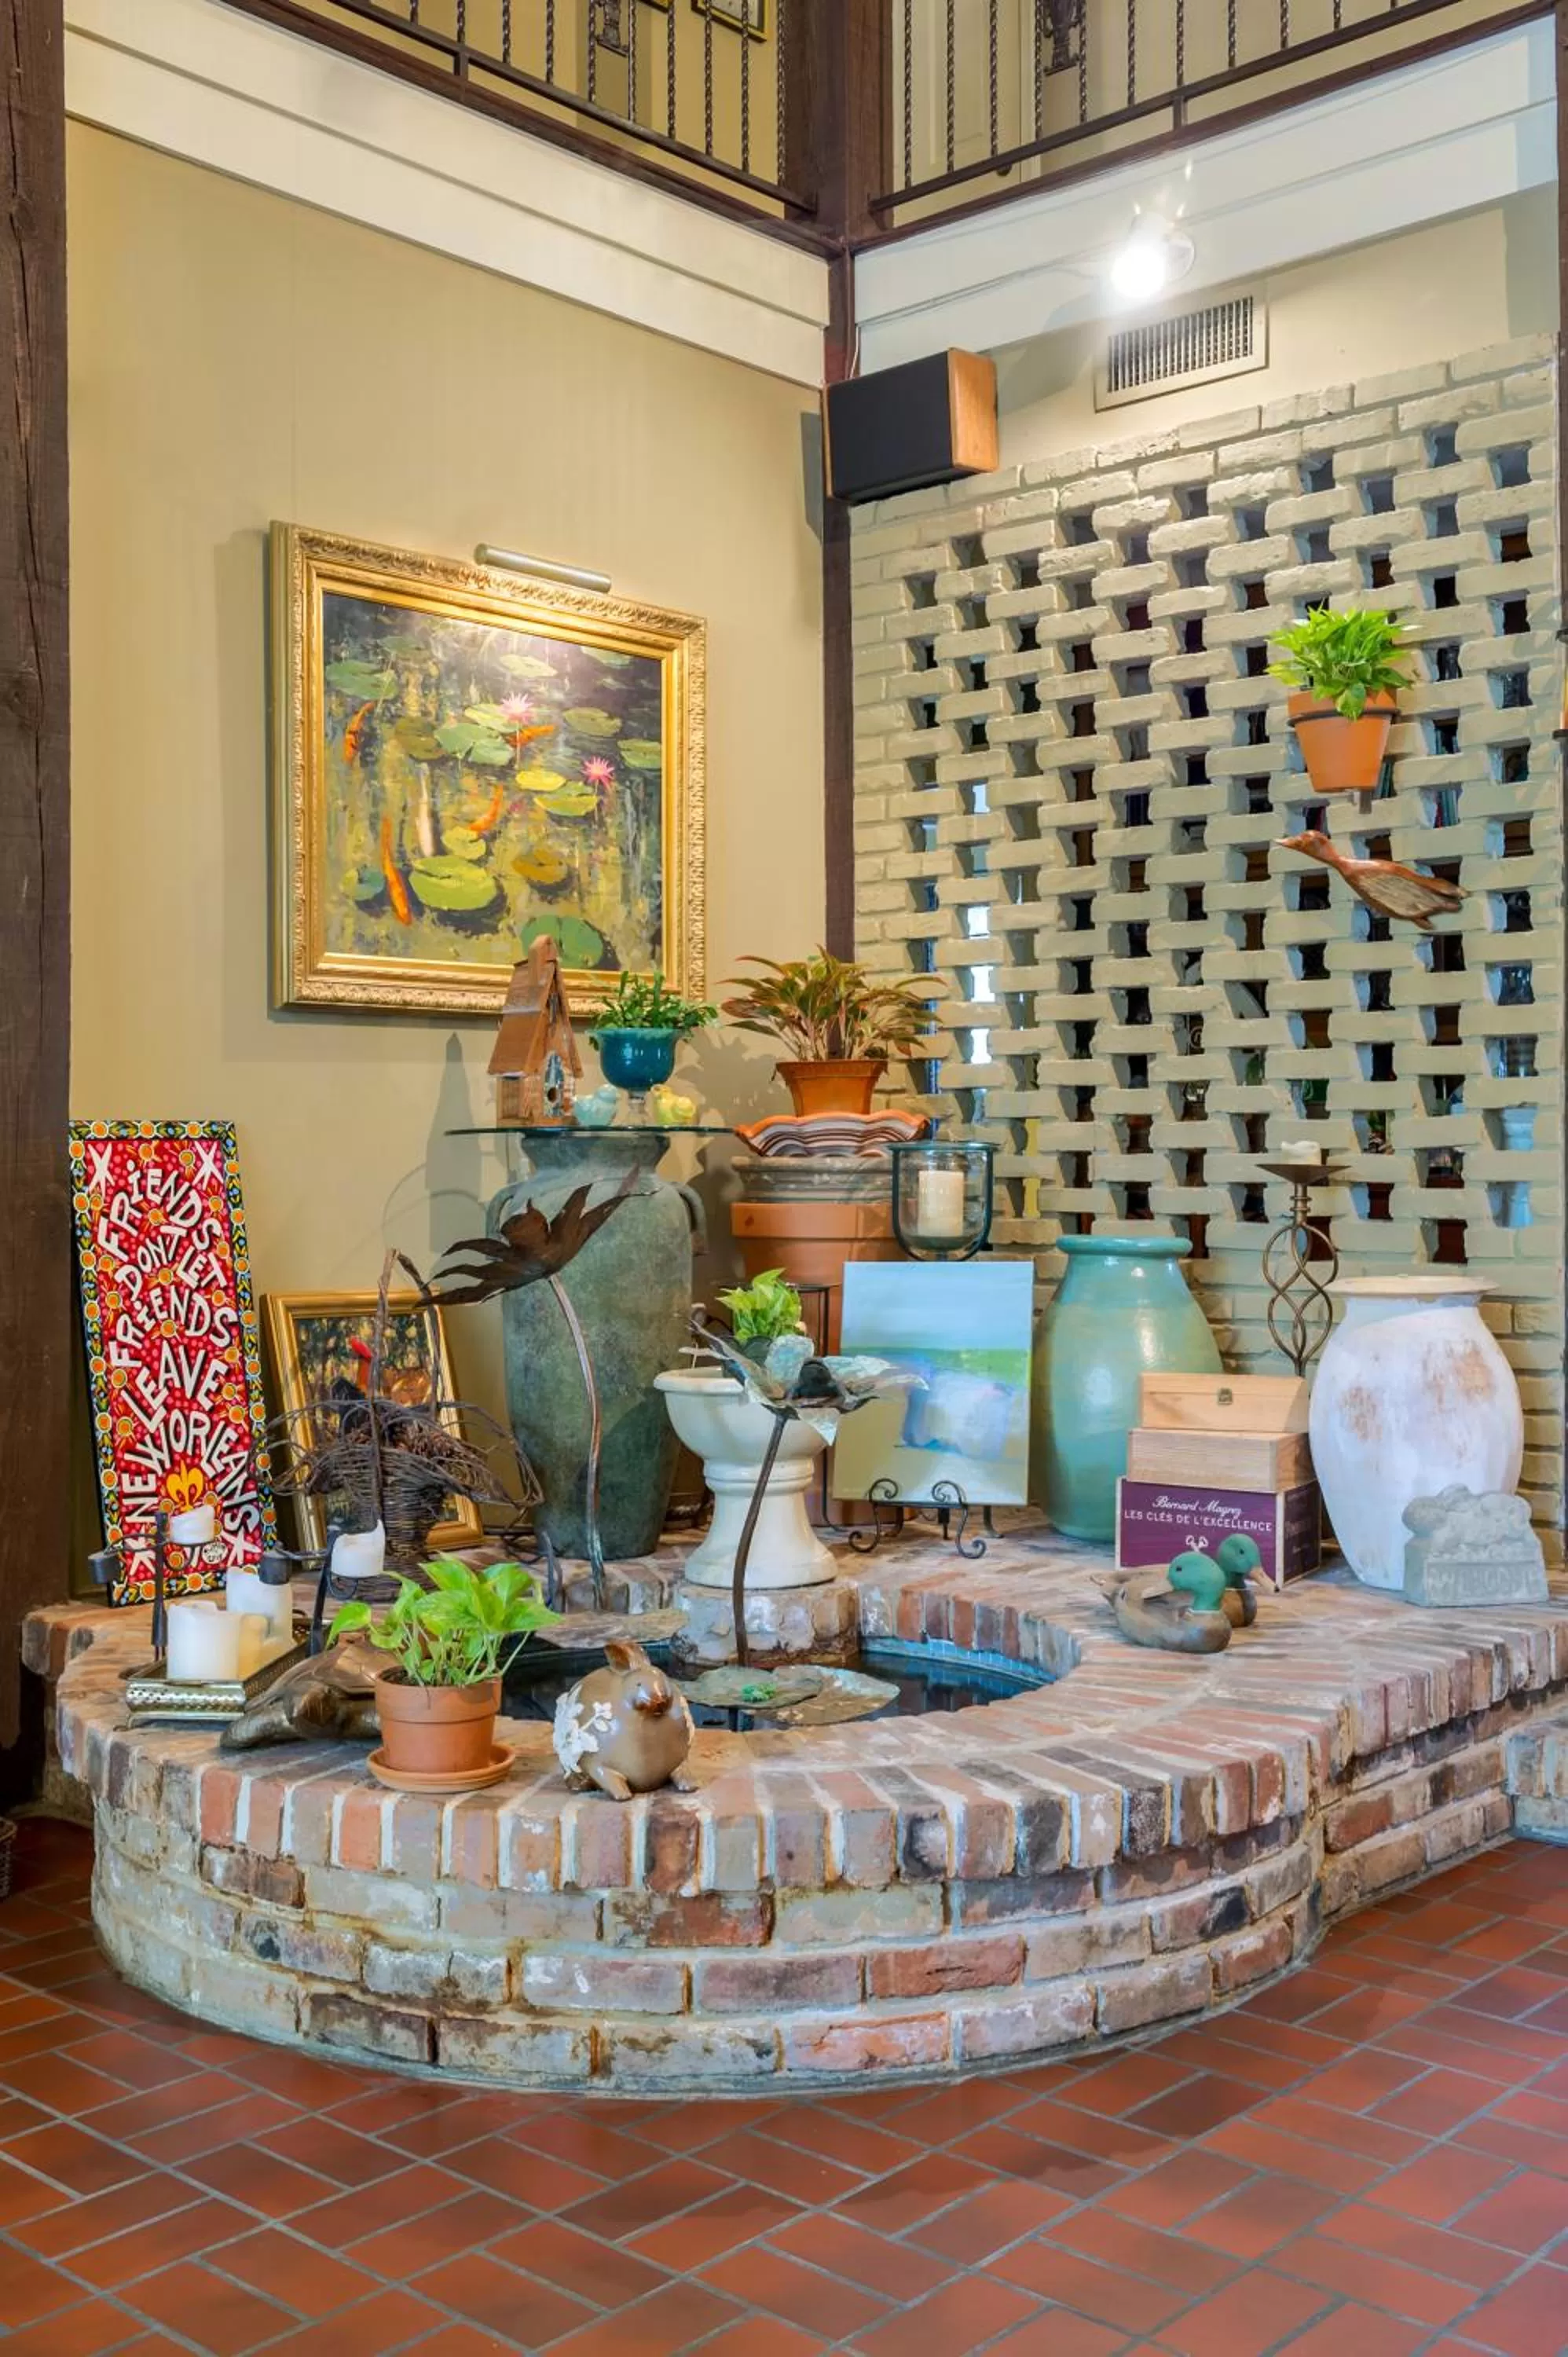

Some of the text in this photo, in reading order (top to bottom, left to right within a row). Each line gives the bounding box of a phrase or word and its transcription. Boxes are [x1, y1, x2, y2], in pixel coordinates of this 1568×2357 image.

[97, 1160, 224, 1263] FRIENDS
[176, 1244, 227, 1289] LET
[108, 1285, 238, 1368] FRIENDS
[120, 1339, 229, 1434] LEAVE
[121, 1408, 260, 1532] NEW ORLEANS
[1152, 1495, 1198, 1512] Bernard
[1123, 1509, 1143, 1520] LES
[1146, 1511, 1173, 1523] CLÉS
[1176, 1515, 1190, 1525] DE
[1193, 1516, 1273, 1532] L'EXCELLENCE
